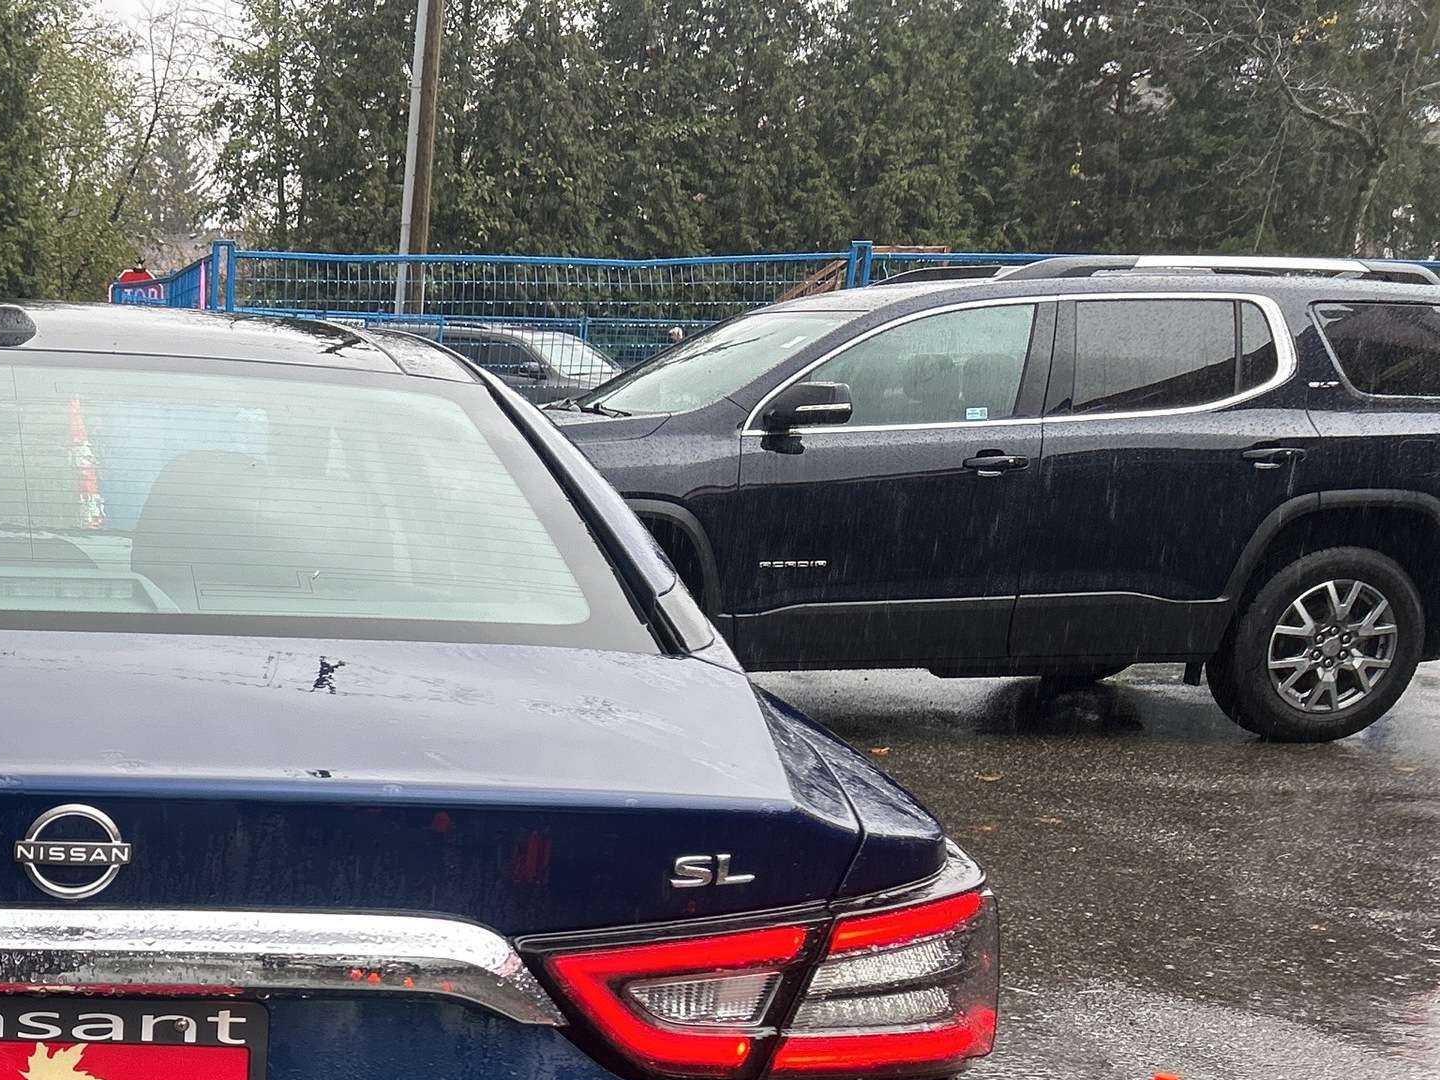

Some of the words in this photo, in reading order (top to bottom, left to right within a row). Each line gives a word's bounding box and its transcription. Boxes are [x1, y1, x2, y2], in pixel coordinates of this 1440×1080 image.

[759, 560, 827, 569] ACADIA
[16, 844, 129, 862] NISSAN
[670, 853, 755, 888] SL
